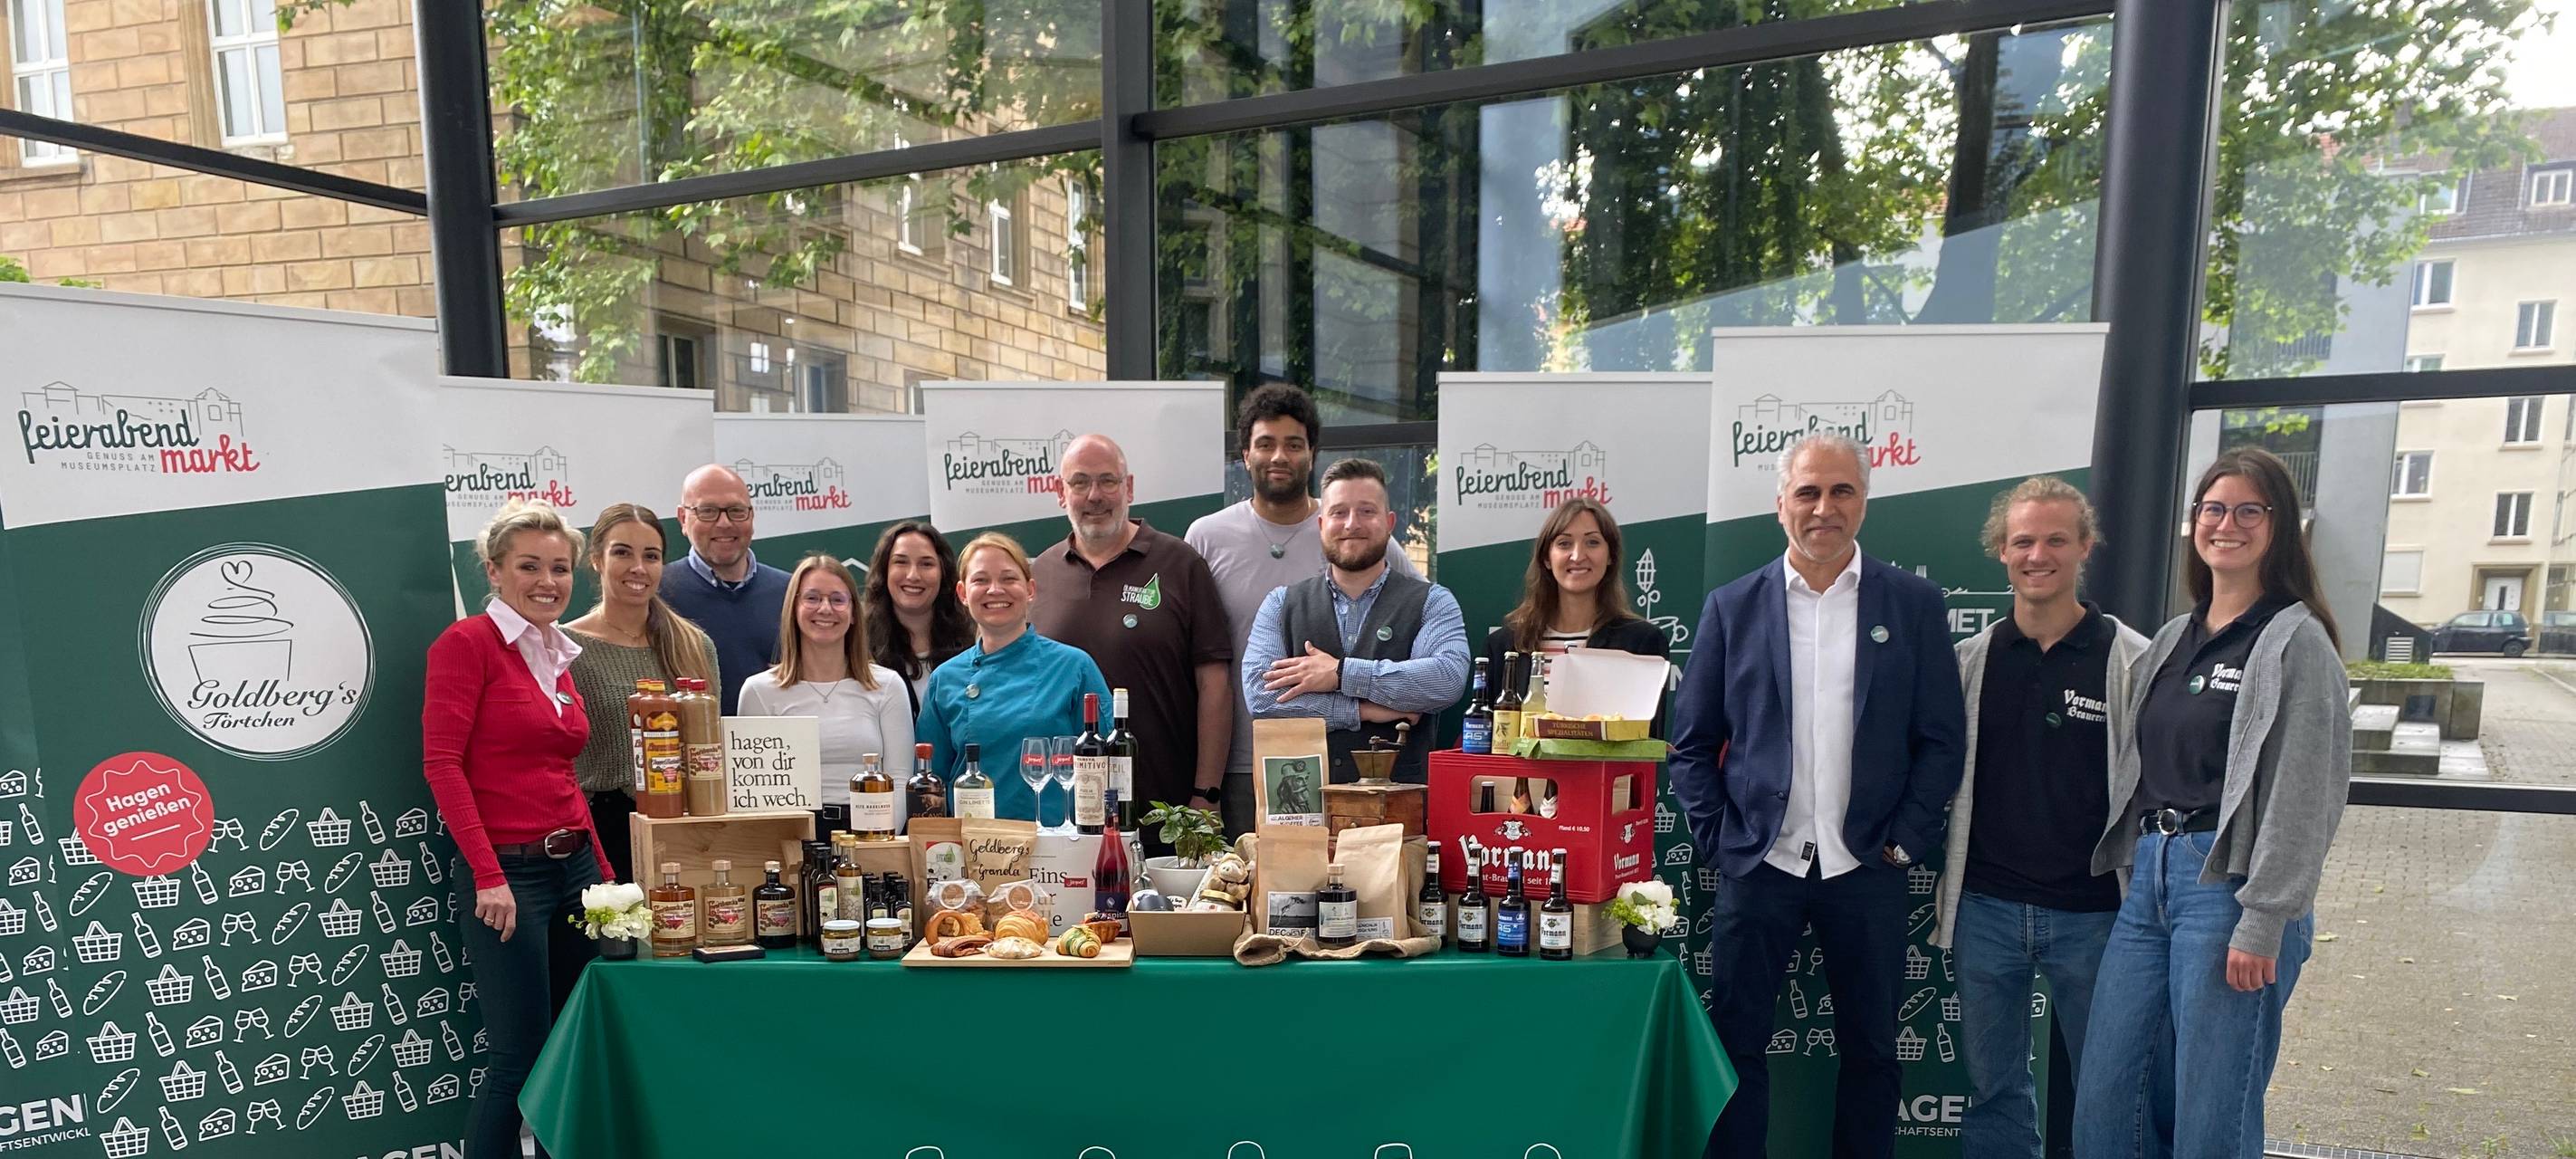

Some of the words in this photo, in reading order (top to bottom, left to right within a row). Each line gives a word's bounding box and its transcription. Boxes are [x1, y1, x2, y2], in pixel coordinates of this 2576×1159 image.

[17, 409, 200, 465] feierabend
[87, 451, 133, 462] GENUSS
[141, 453, 155, 462] AM
[160, 434, 261, 474] markt
[1868, 432, 1921, 467] rkt
[61, 461, 157, 473] MUSEUMSPLATZ
[444, 462, 536, 492] erabend
[944, 446, 1054, 490] feierabend
[747, 471, 818, 498] erabend
[1456, 458, 1573, 505] feierabend
[796, 484, 853, 511] markt
[2211, 663, 2243, 680] Vorma
[2209, 679, 2240, 692] Brauer
[2064, 689, 2107, 713] Vorma
[203, 712, 296, 730] Törtchen
[730, 731, 790, 754] hagen,
[732, 756, 764, 769] von
[772, 752, 796, 771] dir
[731, 767, 791, 787] komm
[105, 782, 171, 812] Hagen
[733, 789, 758, 808] ich
[762, 787, 812, 807] wech.
[103, 797, 191, 837] genießen
[969, 838, 1030, 863] Goldberg's
[1458, 834, 1553, 872] Voran
[978, 863, 1020, 880] Granola
[1028, 867, 1067, 884] Eins
[1897, 1094, 1972, 1123] AGE
[1894, 1126, 1962, 1137] HAFTSENT
